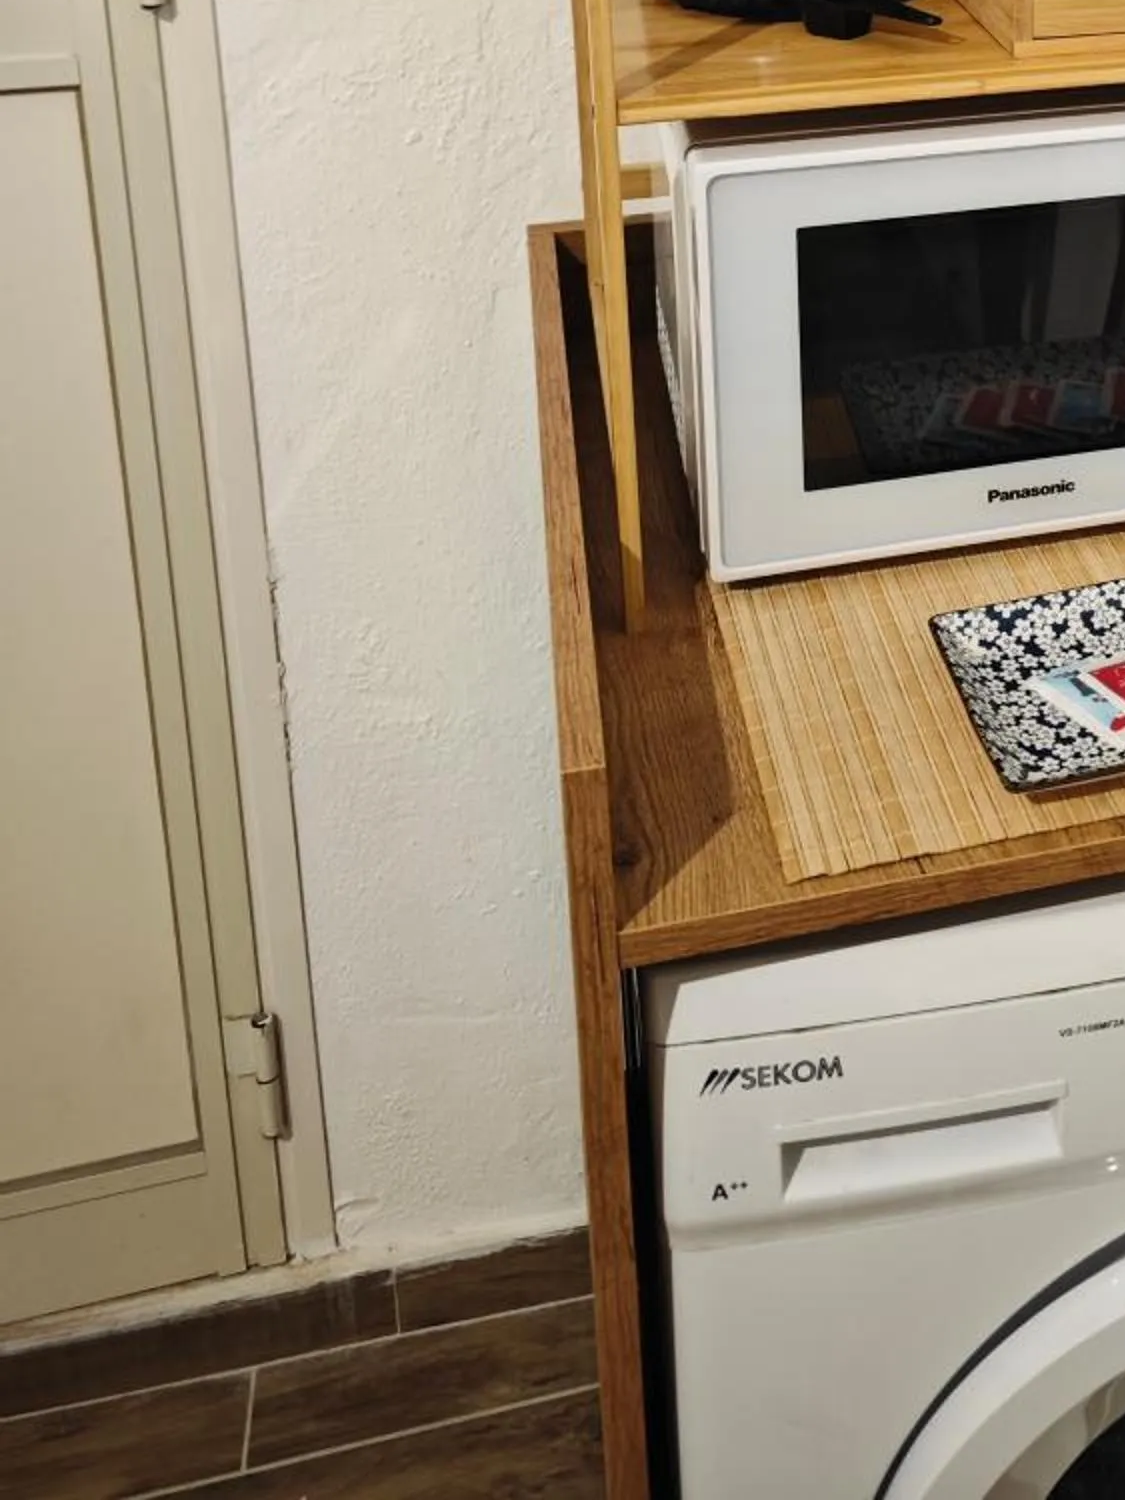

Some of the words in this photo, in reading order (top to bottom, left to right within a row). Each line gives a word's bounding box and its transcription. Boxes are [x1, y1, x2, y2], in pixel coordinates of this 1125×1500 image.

[987, 479, 1075, 502] Panasonic
[740, 1055, 844, 1091] SEKOM
[711, 1181, 748, 1202] A++
